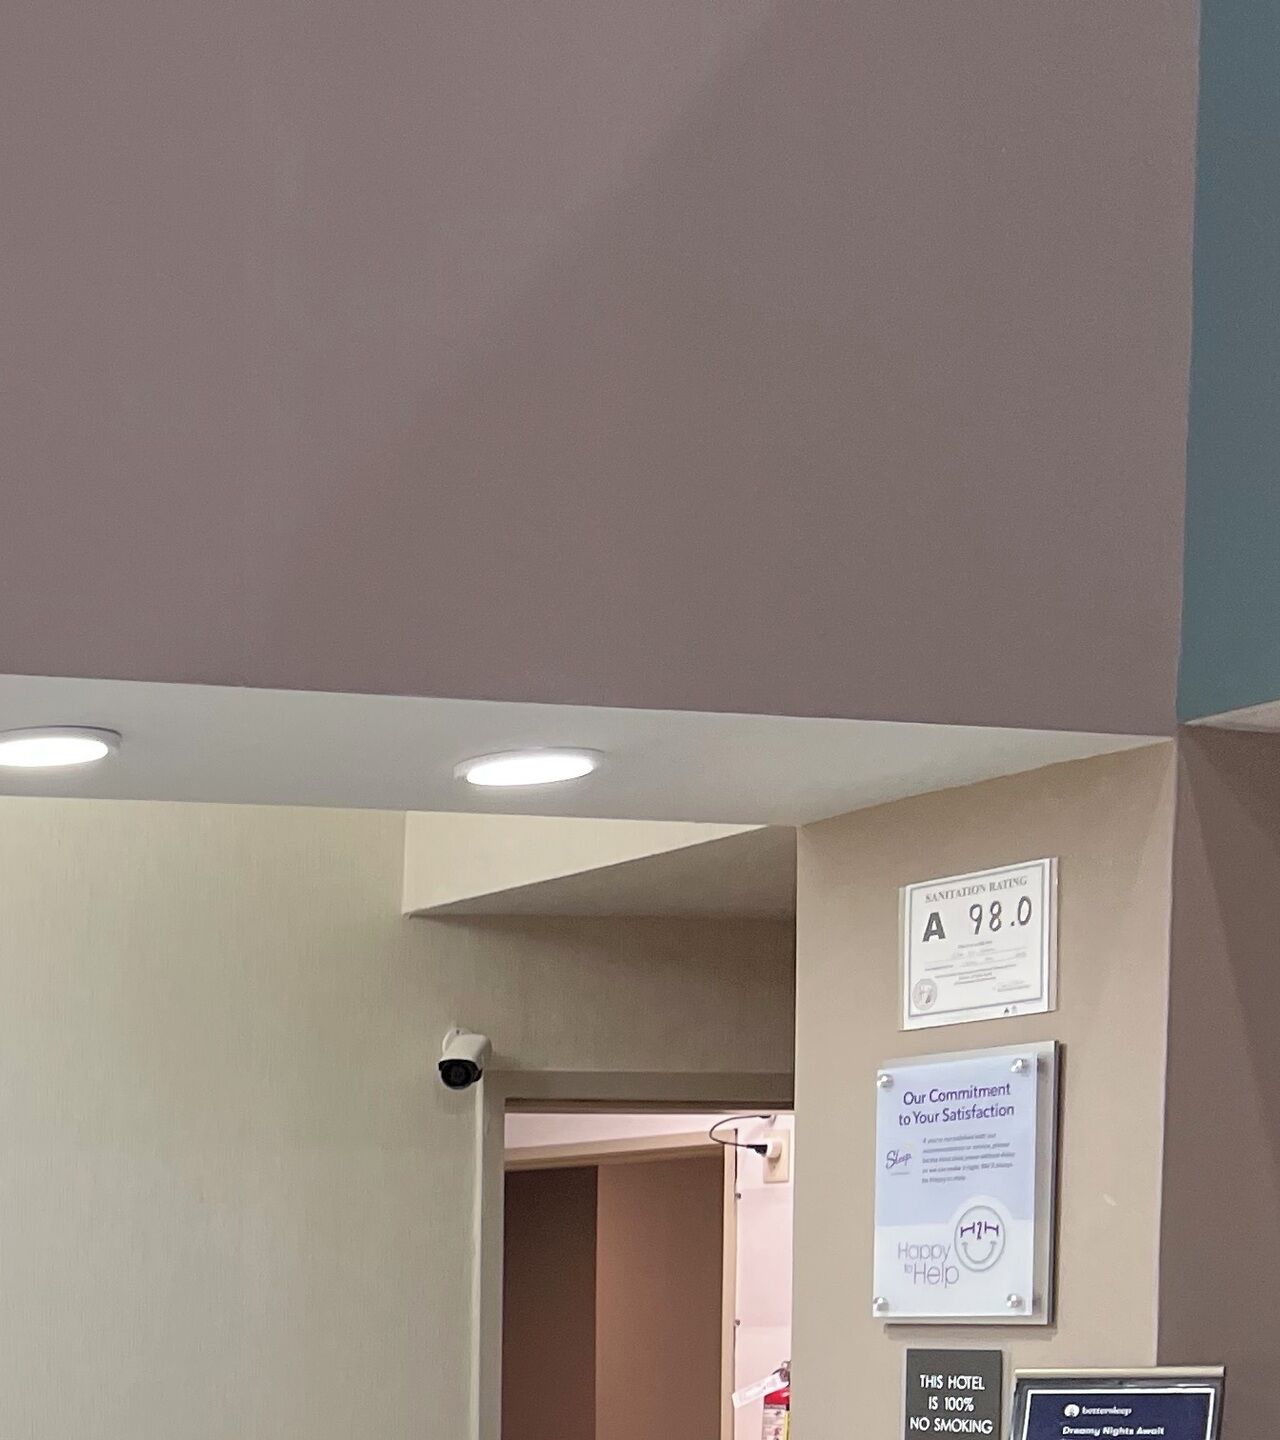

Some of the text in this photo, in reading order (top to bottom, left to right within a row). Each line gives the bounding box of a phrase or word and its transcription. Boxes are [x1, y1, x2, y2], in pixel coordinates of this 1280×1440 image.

[925, 876, 1028, 903] SANITATION RATING
[922, 896, 1032, 942] A 98.0
[903, 1083, 1011, 1105] Our Commitment
[899, 1104, 1014, 1126] to Your Satisfaction
[898, 1242, 951, 1263] Happy
[914, 1262, 959, 1288] Help
[919, 1374, 985, 1390] THIS HOTEL
[928, 1396, 974, 1412] IS 100%
[910, 1416, 993, 1434] NO SMOKING
[1062, 1426, 1165, 1436] Dreamy Nights Await
